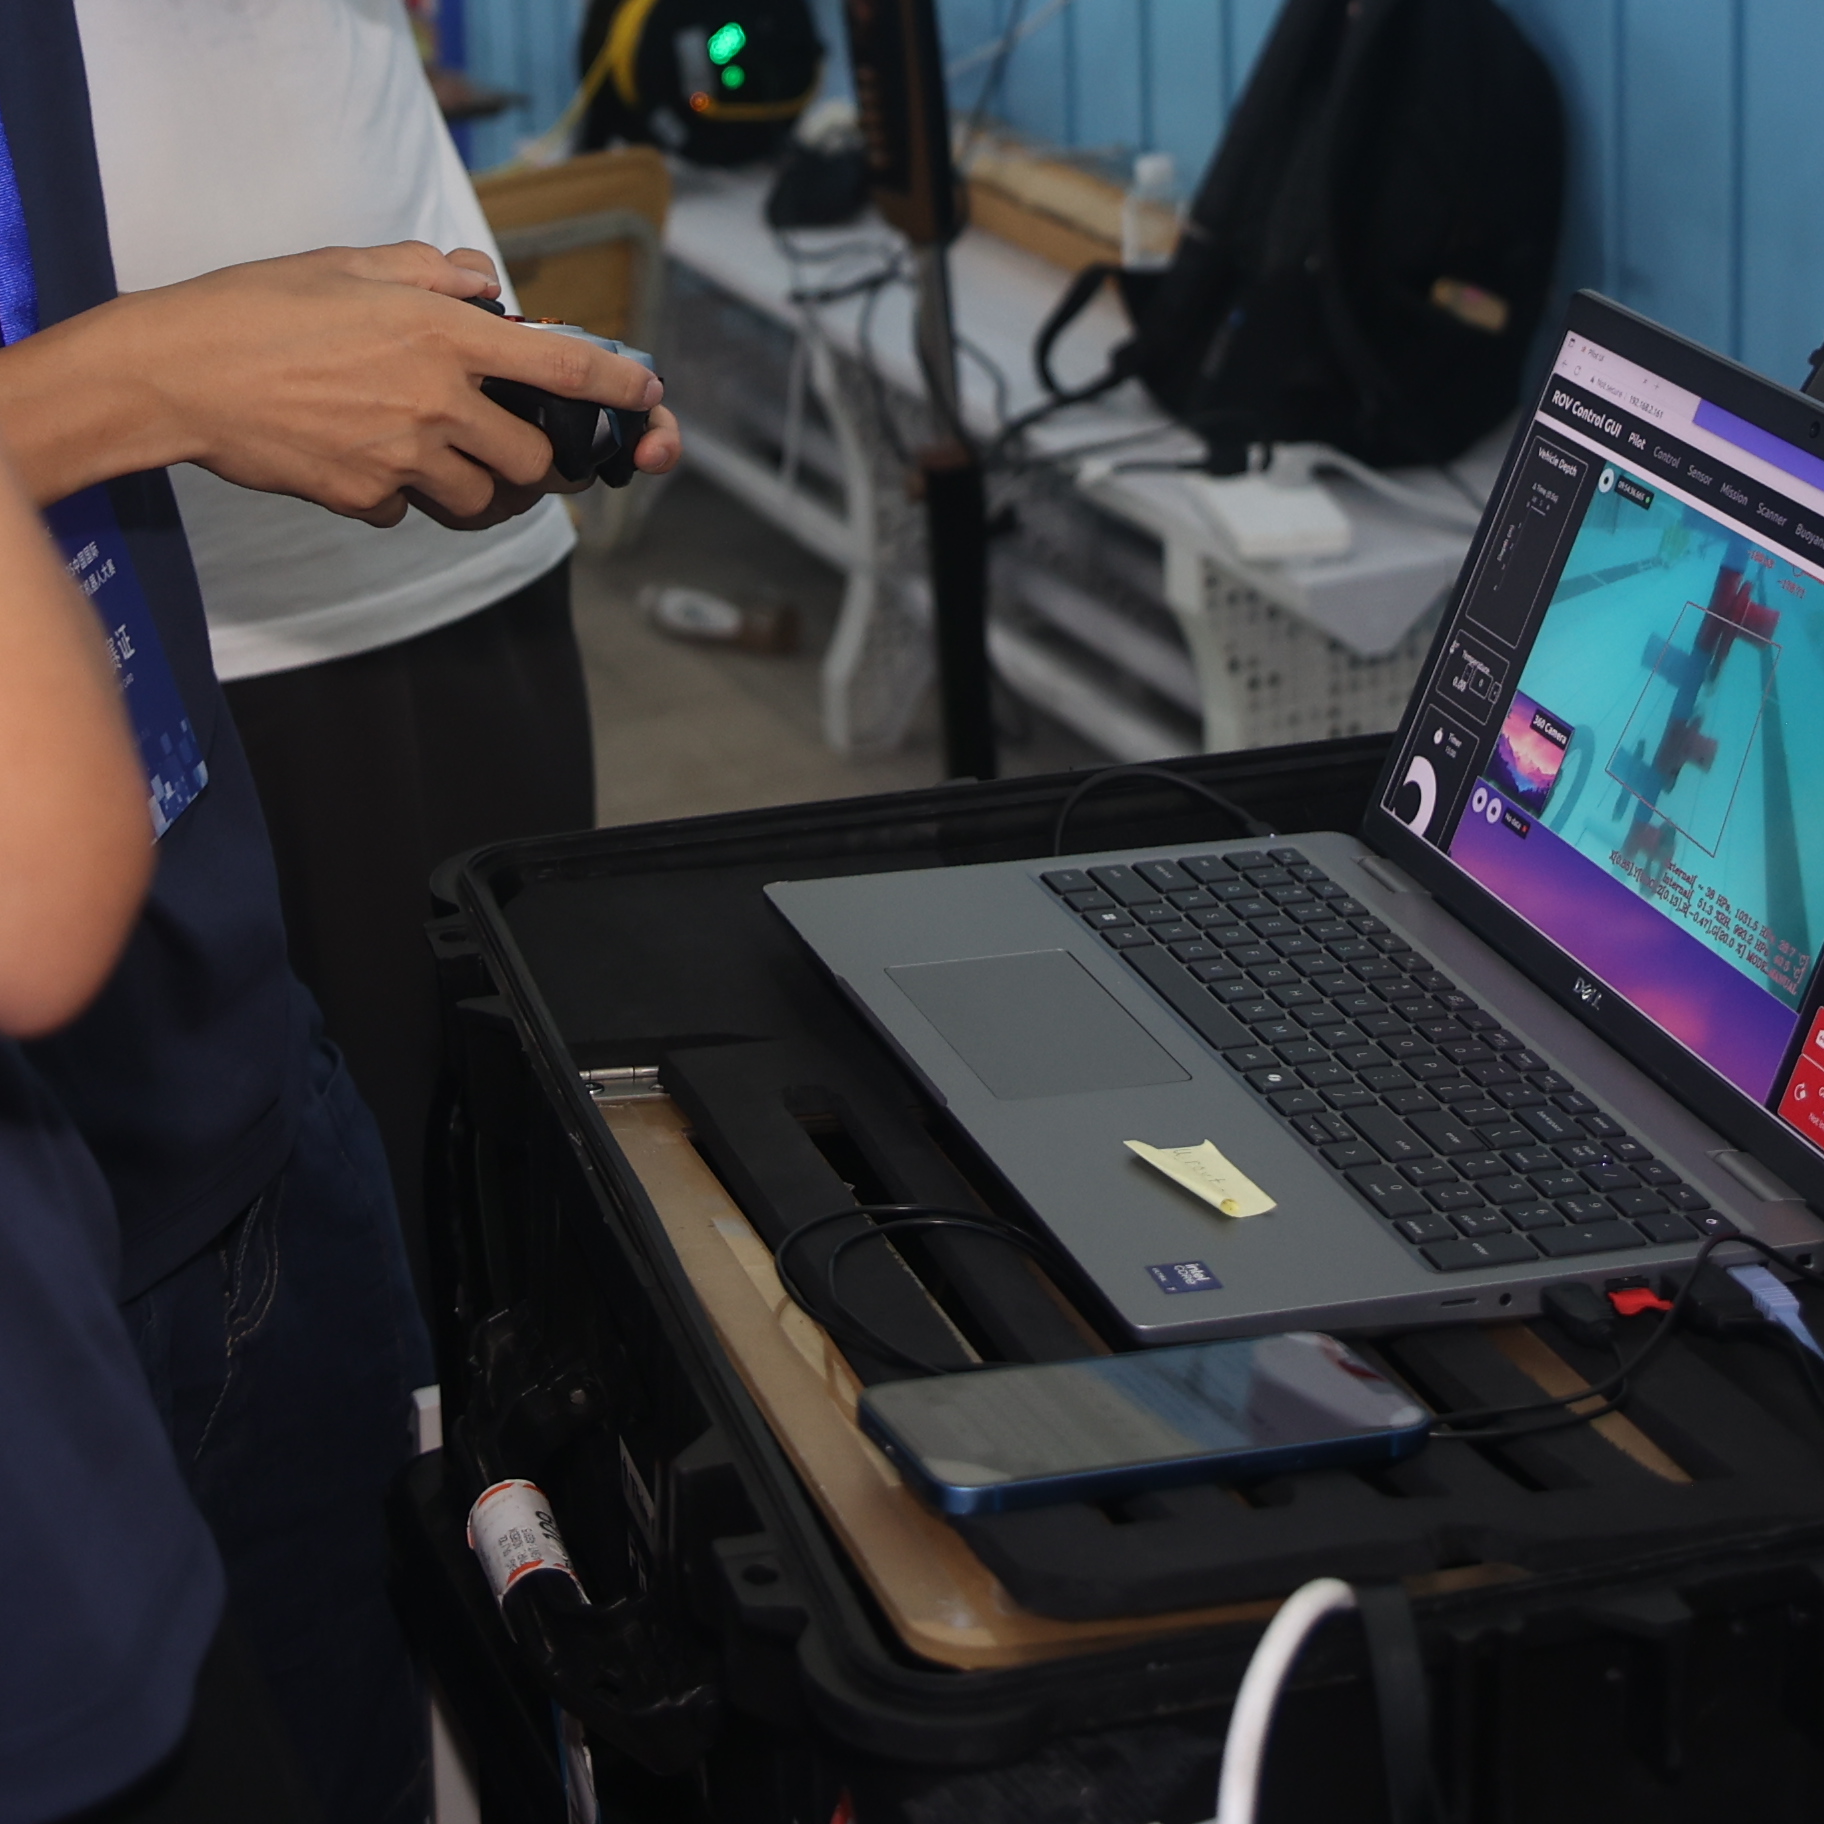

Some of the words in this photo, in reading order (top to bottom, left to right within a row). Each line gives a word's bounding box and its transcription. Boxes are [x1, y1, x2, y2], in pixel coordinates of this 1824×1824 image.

[1552, 389, 1573, 411] ROV
[1571, 399, 1606, 429] Control
[1604, 418, 1623, 438] GUI
[1537, 446, 1559, 467] Vehicle
[1558, 459, 1578, 477] Depth
[1627, 430, 1648, 451] Pilot
[1653, 445, 1682, 469] Control
[1687, 463, 1714, 486] Sensor
[1719, 482, 1749, 507] Mission
[1755, 502, 1788, 527] Scanner
[1447, 732, 1463, 748] Timer
[1532, 713, 1546, 730] 360
[1543, 720, 1568, 746] Camera
[1808, 1112, 1821, 1127] Not
[1184, 1262, 1212, 1283] intel
